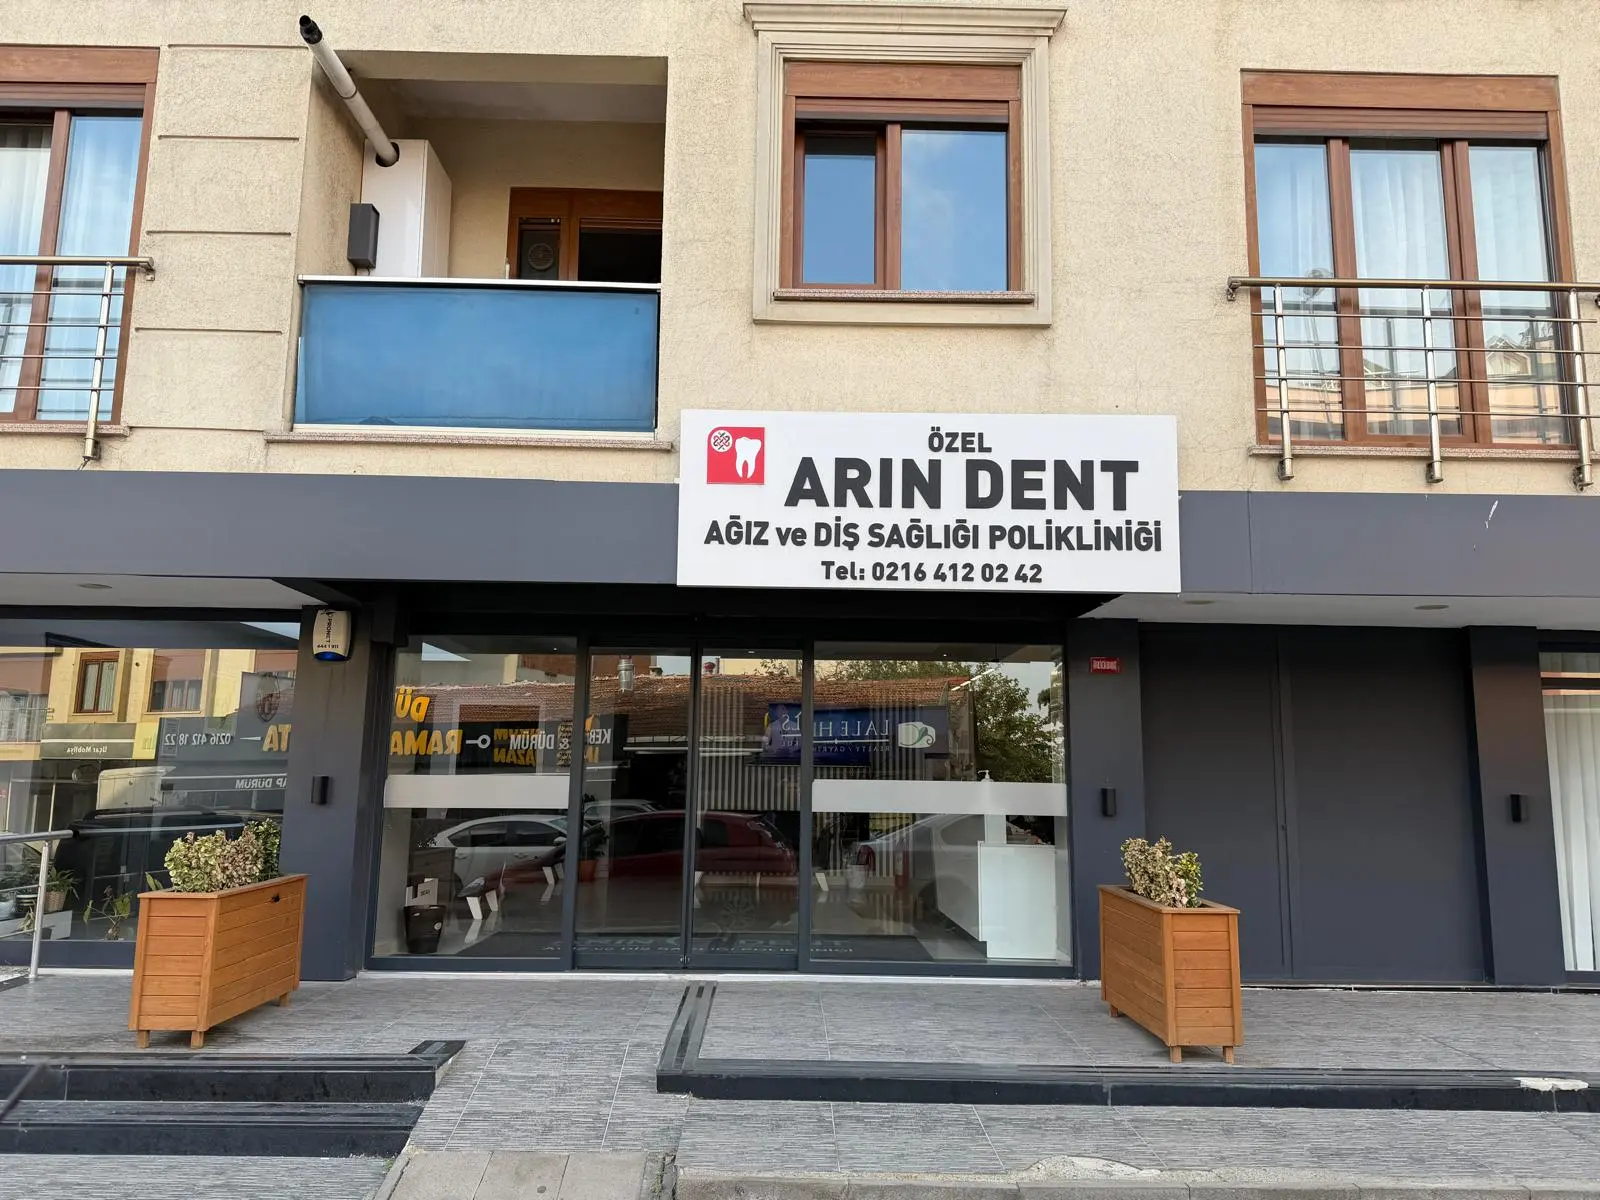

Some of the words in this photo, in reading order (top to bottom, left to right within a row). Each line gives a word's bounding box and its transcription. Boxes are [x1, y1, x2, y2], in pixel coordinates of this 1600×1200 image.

[928, 426, 992, 453] ÖZEL
[783, 456, 942, 510] ARIN
[965, 458, 1139, 511] DENT
[703, 514, 770, 546] AĞIZ
[775, 527, 807, 547] ve
[814, 515, 860, 551] DİŞ
[867, 518, 979, 550] SAĞLIĞI
[989, 518, 1162, 552] POLİKLİNİĞİ
[820, 560, 865, 581] Tel:
[871, 561, 927, 582] 0216
[933, 562, 975, 583] 412
[981, 563, 1009, 583] 02
[1014, 563, 1042, 584] 42
